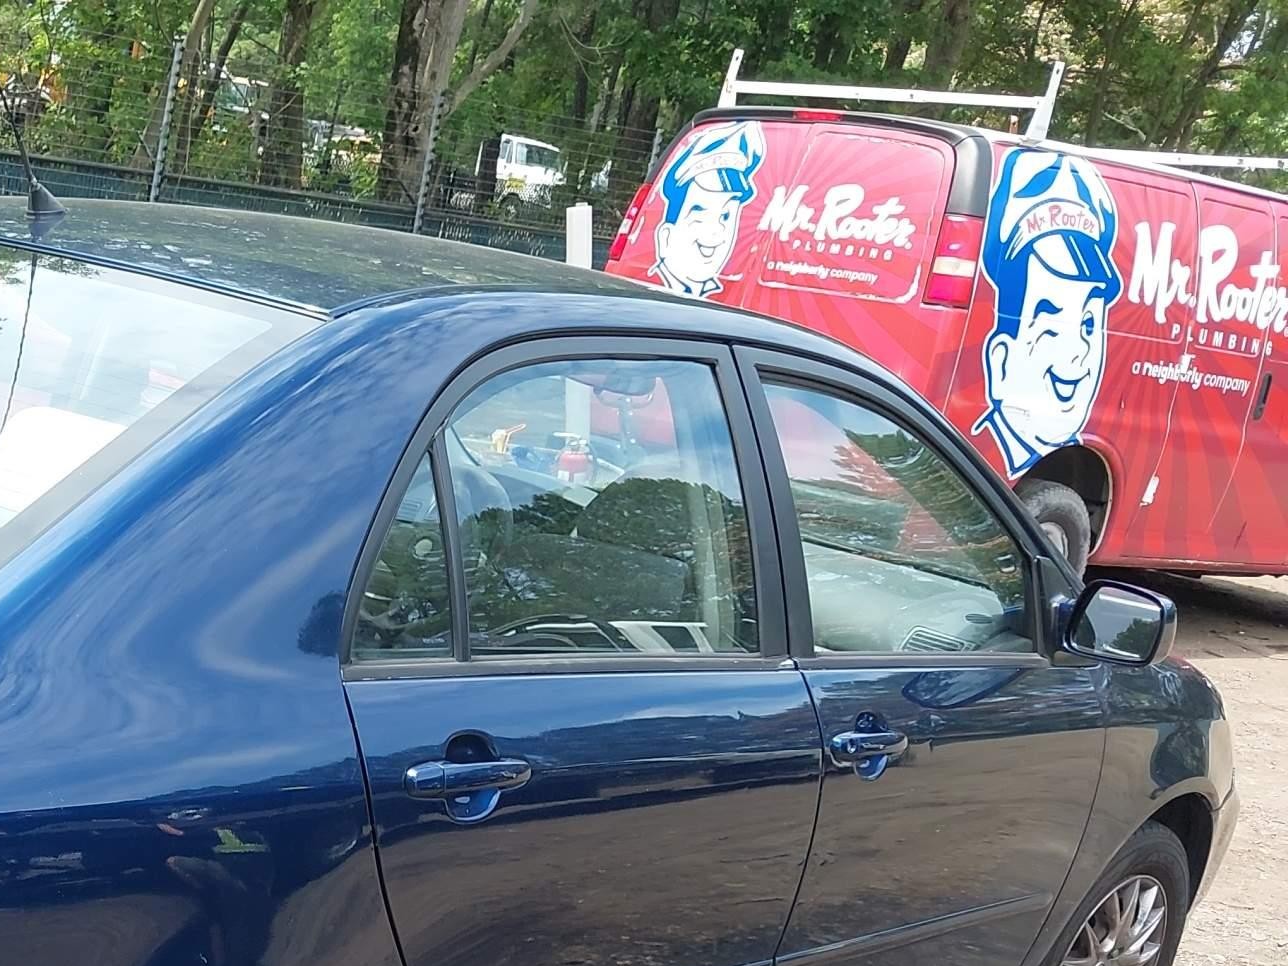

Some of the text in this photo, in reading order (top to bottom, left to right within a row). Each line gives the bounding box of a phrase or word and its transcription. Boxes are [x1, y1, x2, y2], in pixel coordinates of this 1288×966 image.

[1048, 204, 1095, 233] Rooter
[792, 239, 894, 261] PLUMBING
[767, 260, 879, 286] a neighborly company
[1128, 221, 1196, 324] Mr.
[1171, 323, 1273, 356] PLUMBING
[1132, 361, 1141, 375] a
[1203, 372, 1251, 397] company
